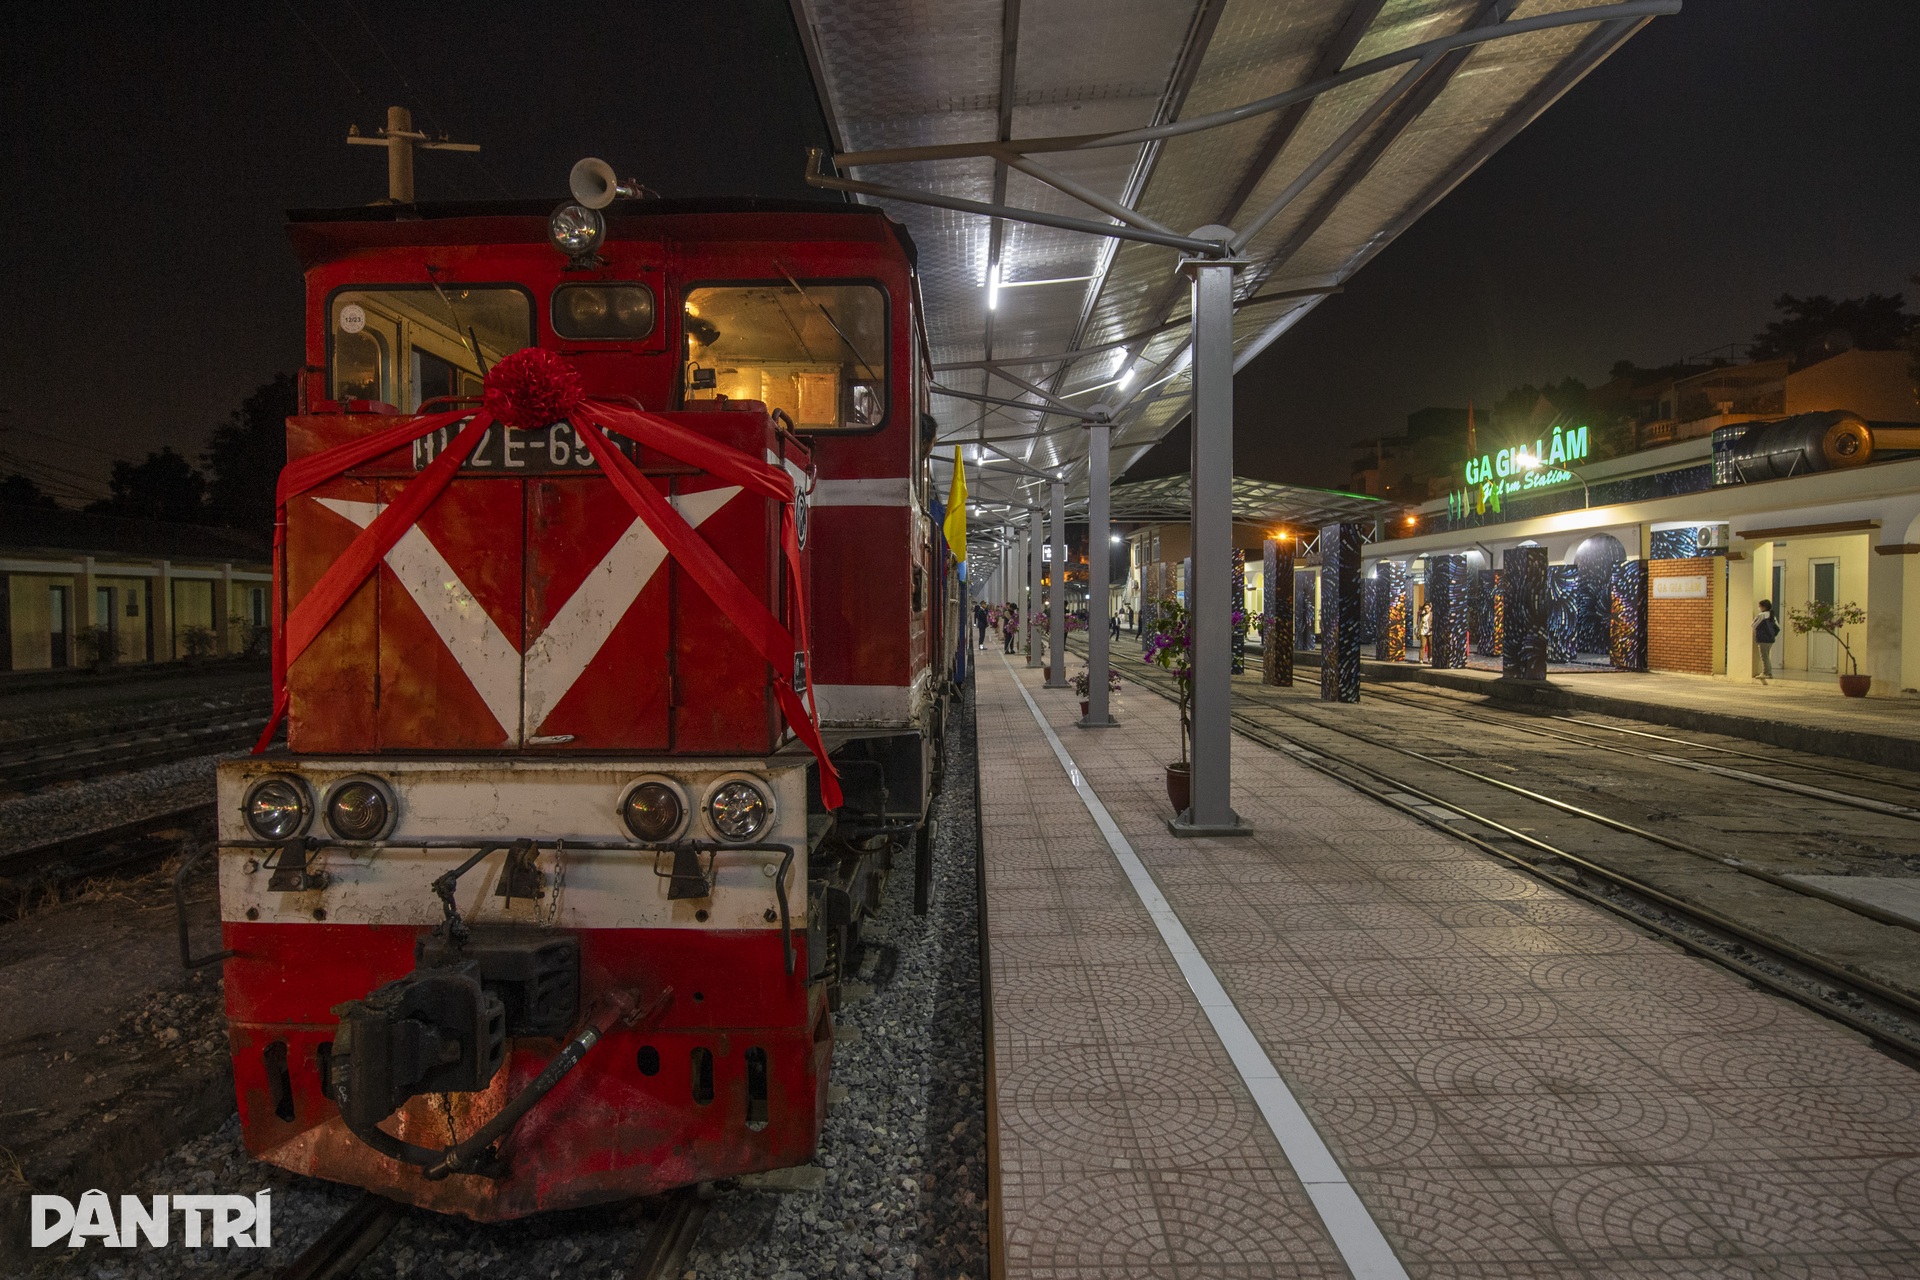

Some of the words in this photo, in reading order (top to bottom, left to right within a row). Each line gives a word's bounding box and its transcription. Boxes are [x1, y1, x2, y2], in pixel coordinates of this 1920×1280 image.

[1466, 456, 1493, 485] GA
[1536, 426, 1587, 467] LÂM
[1524, 470, 1572, 490] Station
